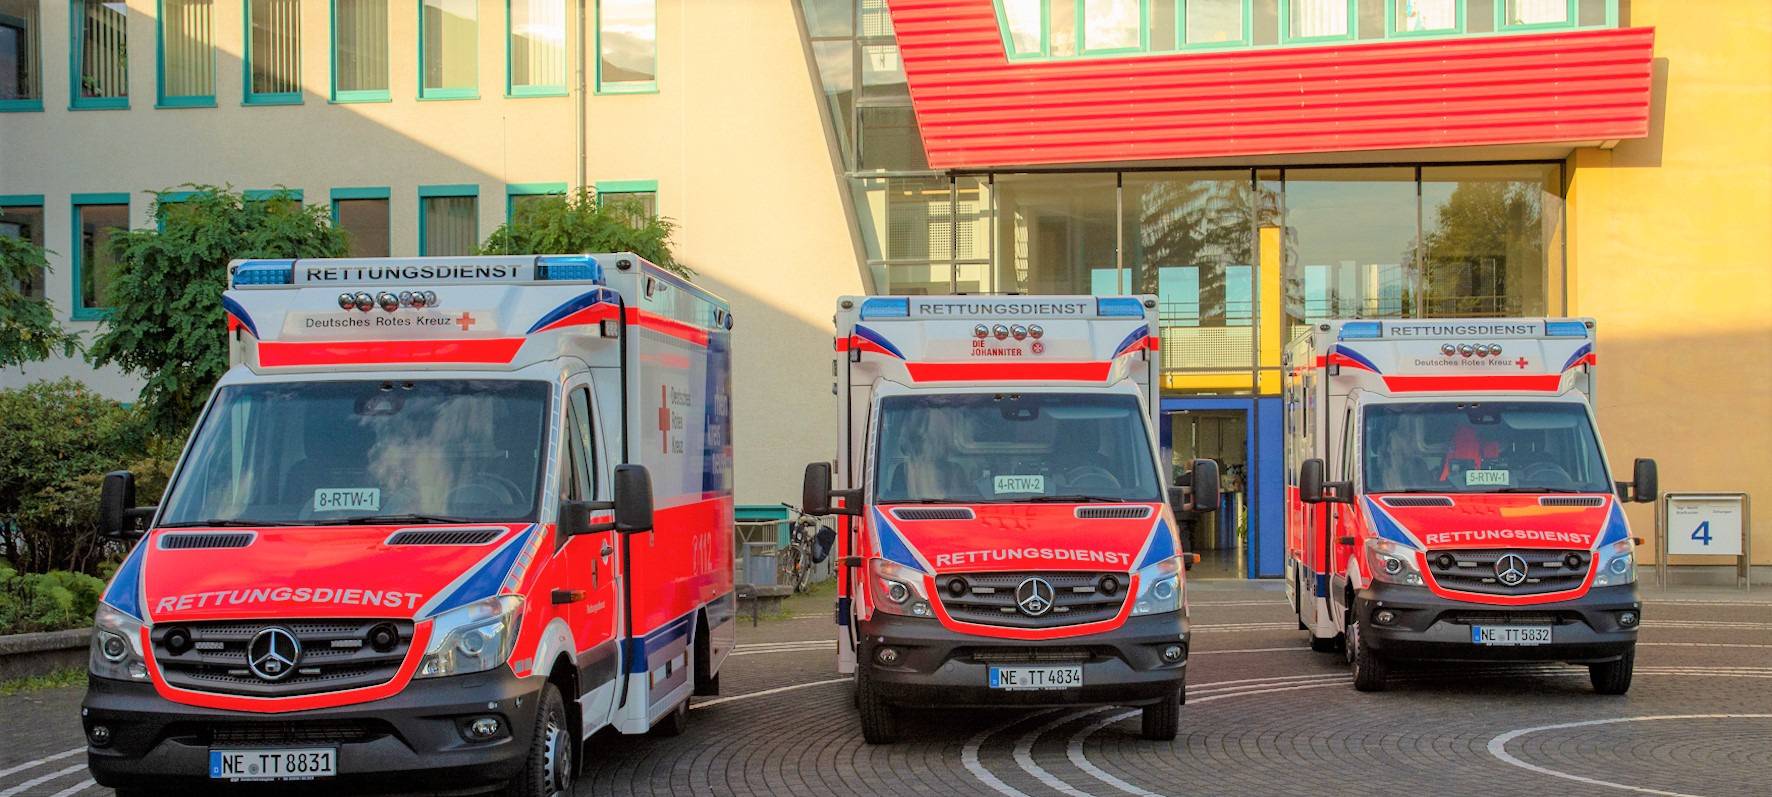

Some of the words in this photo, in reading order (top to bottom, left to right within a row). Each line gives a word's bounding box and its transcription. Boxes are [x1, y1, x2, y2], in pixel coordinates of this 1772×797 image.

[306, 264, 522, 282] RETTUNGSDIENST
[919, 302, 1088, 316] RETTUNGSDIENST
[305, 316, 371, 328] Deutsches
[376, 316, 411, 327] Rotes
[416, 316, 451, 326] Kreuz
[1391, 325, 1536, 336] RETTUNGSDIENST
[972, 340, 985, 348] DIE
[970, 348, 1022, 356] JOHANNITER
[1414, 358, 1458, 367] Deutsches
[1461, 359, 1485, 367] Rotes
[998, 478, 1040, 490] 4-RTW-2
[1470, 472, 1505, 482] 5-RTW-1
[319, 491, 375, 507] 8-RTW-1
[1425, 529, 1592, 545] RETTUNGSDIENST
[1691, 520, 1713, 546] 4
[936, 547, 1130, 568] RETTUNGSDIENST
[155, 587, 423, 614] RETTUNGSDIENST
[1481, 629, 1496, 641] NE
[1505, 629, 1519, 641] TT
[1521, 629, 1549, 641] 5832
[1000, 670, 1017, 685] NE
[1028, 670, 1045, 685] TT
[1048, 670, 1080, 684] 4834
[223, 754, 245, 774] NE
[259, 754, 281, 773] TT
[286, 753, 331, 773] 8831
